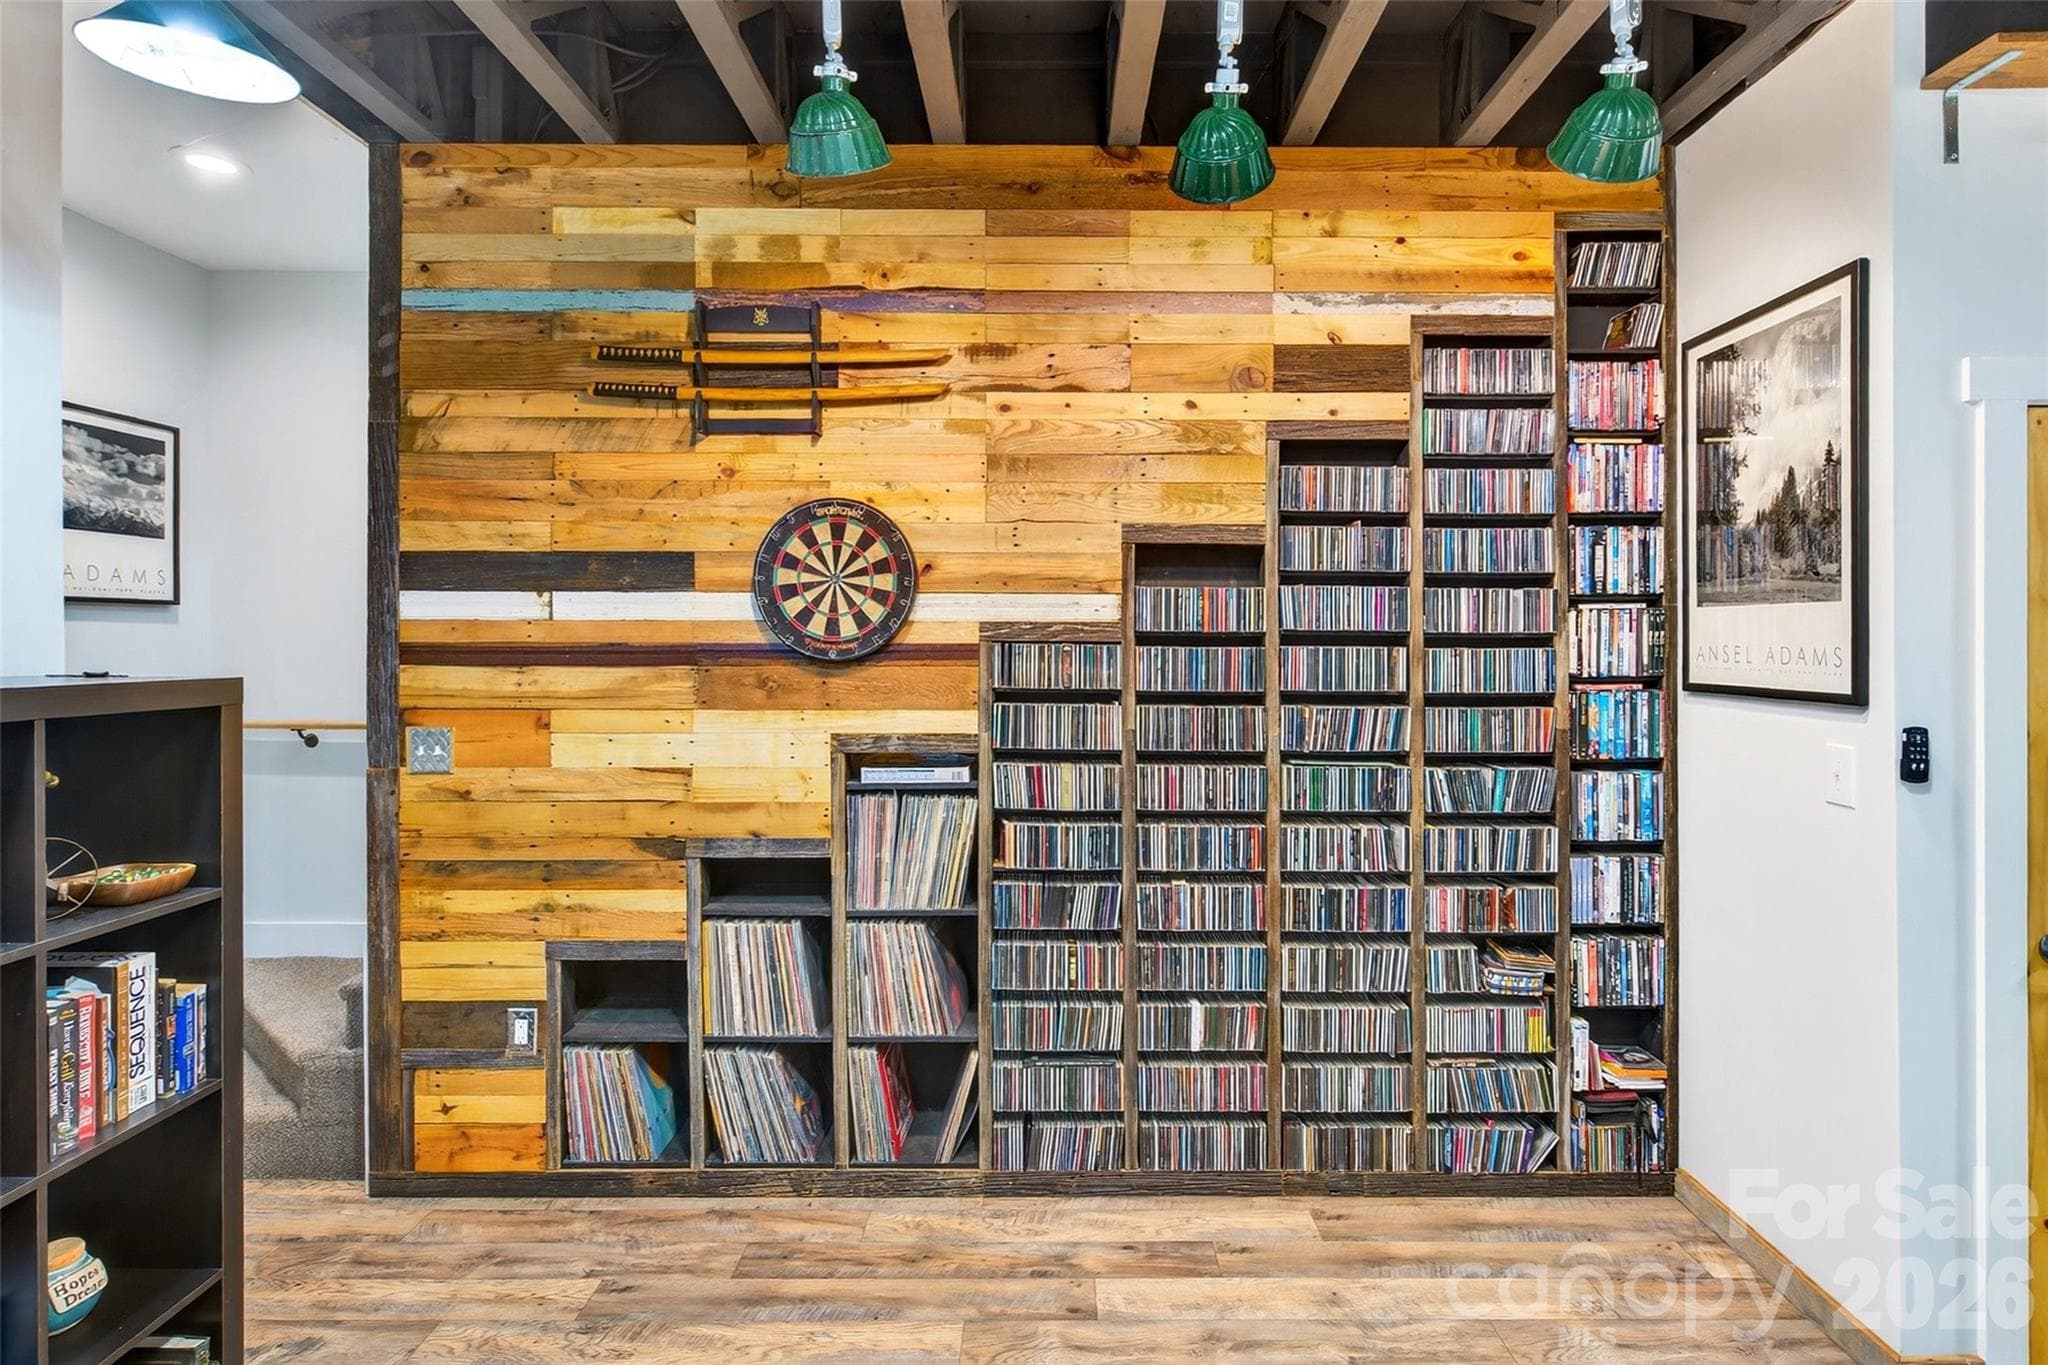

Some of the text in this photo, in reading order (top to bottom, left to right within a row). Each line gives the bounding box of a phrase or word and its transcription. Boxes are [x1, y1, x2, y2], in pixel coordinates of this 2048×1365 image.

[64, 563, 166, 586] ADAMS
[1695, 644, 1843, 669] ANSEL ADAMS
[129, 966, 146, 1079] SEQUENCE
